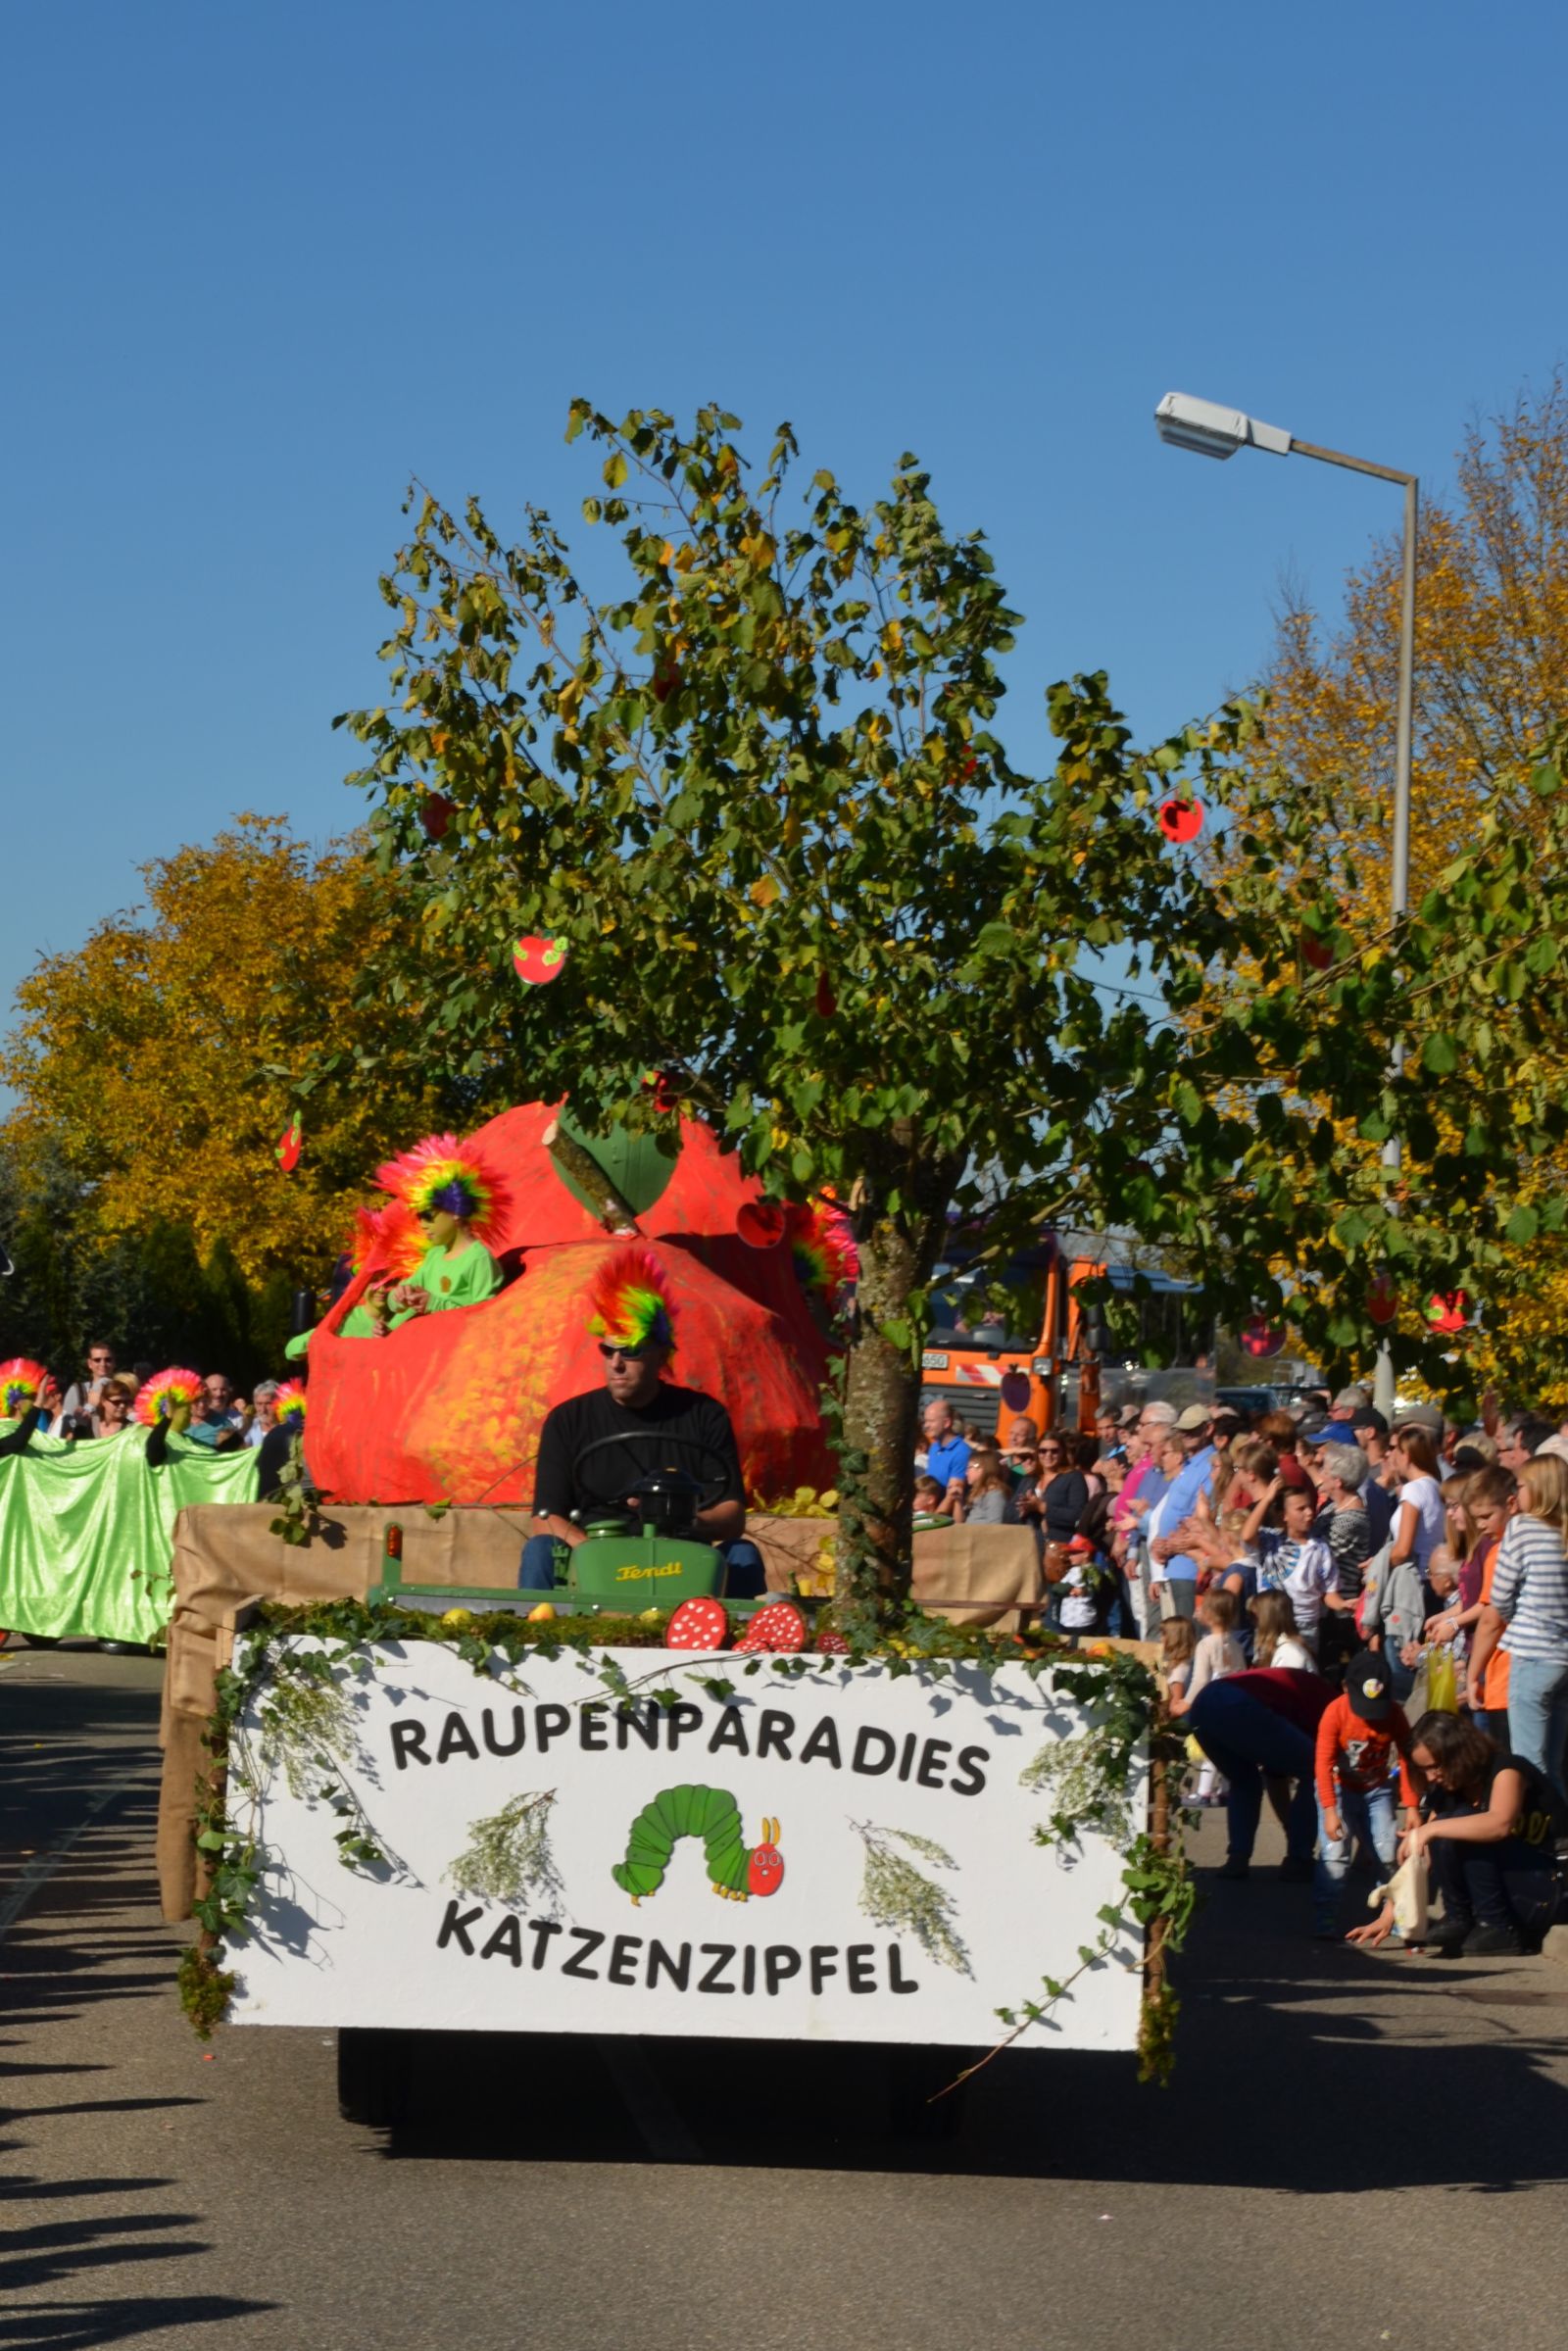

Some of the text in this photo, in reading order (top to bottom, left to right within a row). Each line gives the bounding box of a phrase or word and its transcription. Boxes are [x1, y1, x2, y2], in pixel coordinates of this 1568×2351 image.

[614, 1561, 682, 1582] Fendt
[390, 1701, 990, 1795] RAUPENPARADIES
[436, 1899, 919, 1996] KATZENZIPFEL
